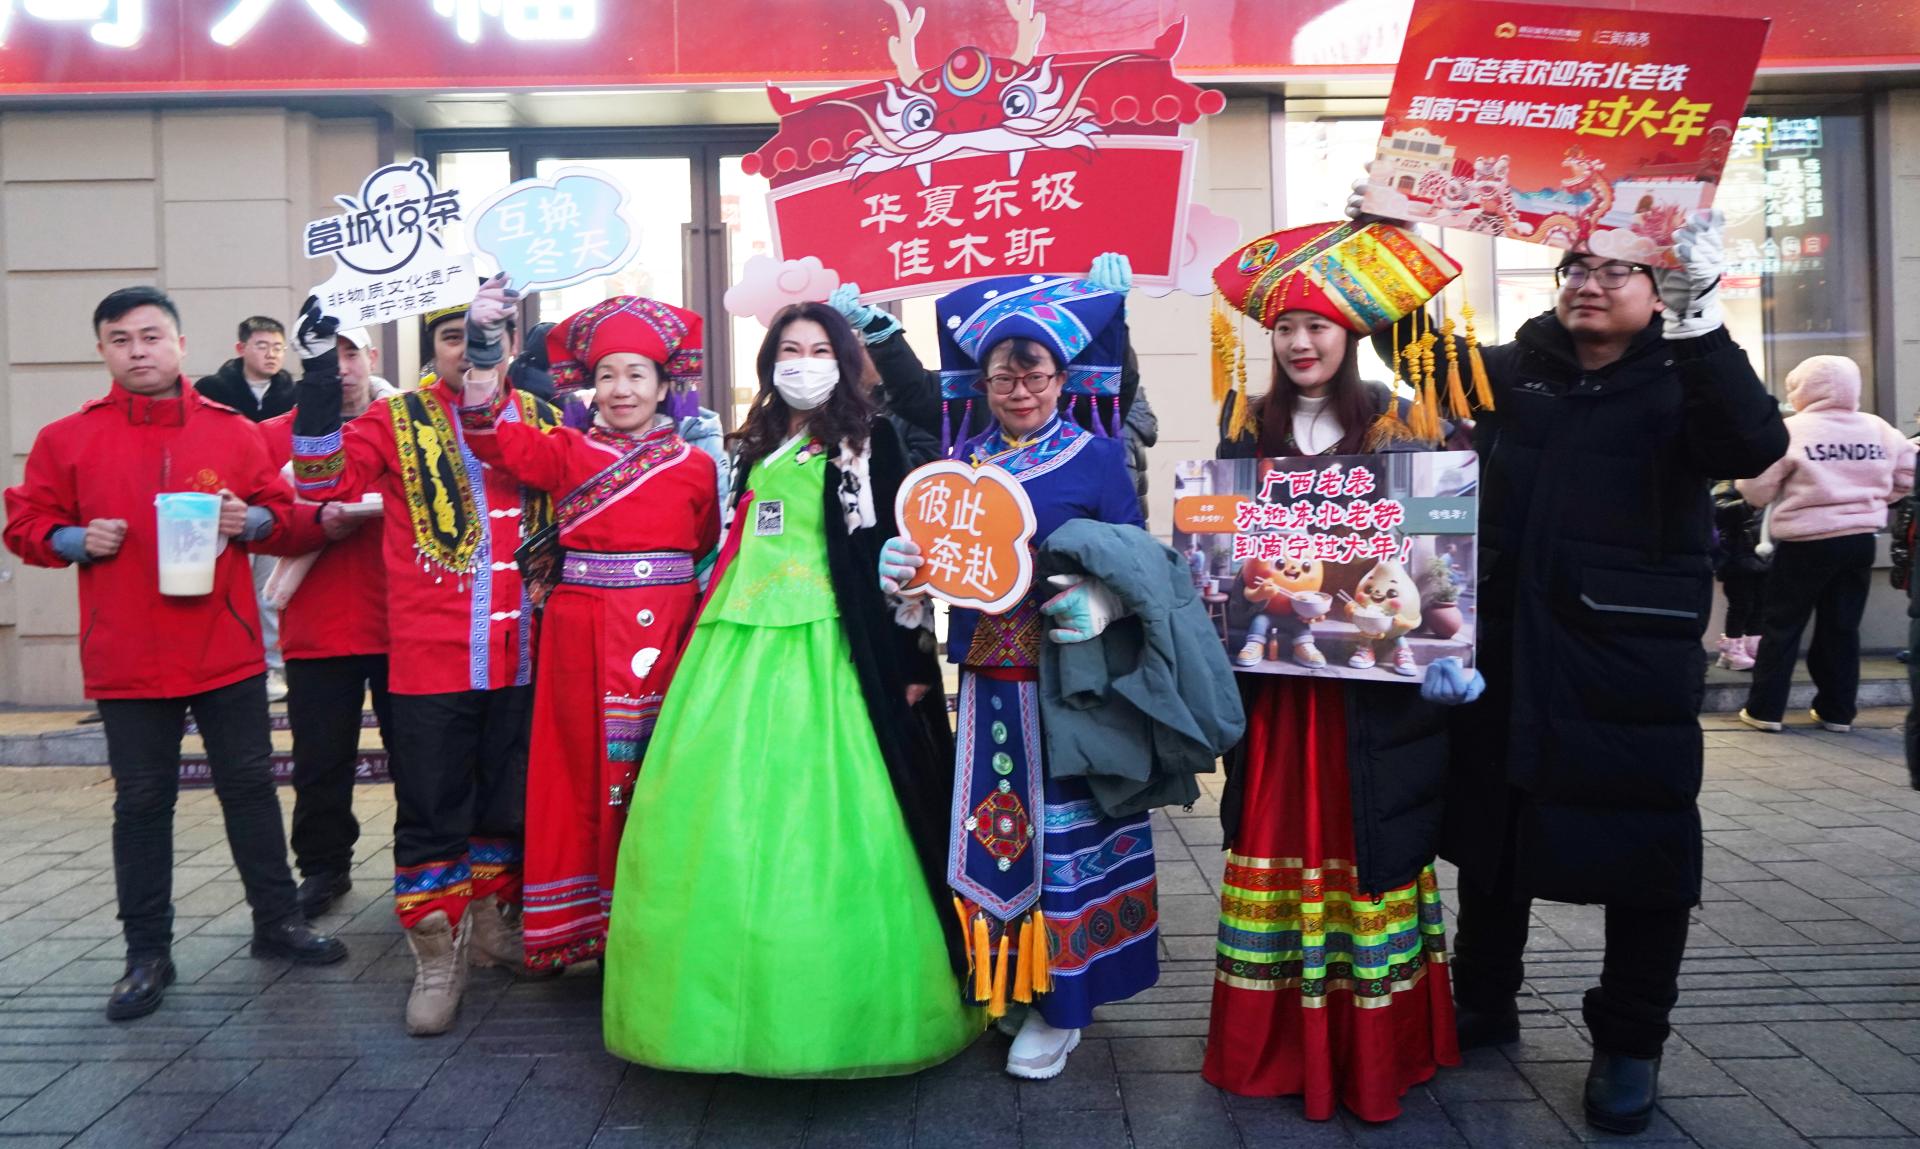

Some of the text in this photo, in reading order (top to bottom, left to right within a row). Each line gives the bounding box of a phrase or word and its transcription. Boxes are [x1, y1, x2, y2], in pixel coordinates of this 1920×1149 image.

[1425, 56, 1690, 92] 广西老表欢迎东北老铁
[1404, 95, 1713, 146] 到南宁邕州古城过大年
[308, 189, 463, 256] 邕城凉茶
[496, 191, 582, 242] 互换
[860, 170, 1084, 234] 华夏东极
[525, 229, 614, 274] 冬天
[887, 227, 1055, 279] 佳木斯
[328, 265, 464, 307] 非物质文化遗产
[917, 479, 986, 536] 彼此
[1258, 464, 1376, 500] 广西老表
[1234, 499, 1405, 530] 欢迎东北老铁
[926, 535, 1000, 598] 奔赴
[1232, 531, 1414, 565] 到南宁过大年!
